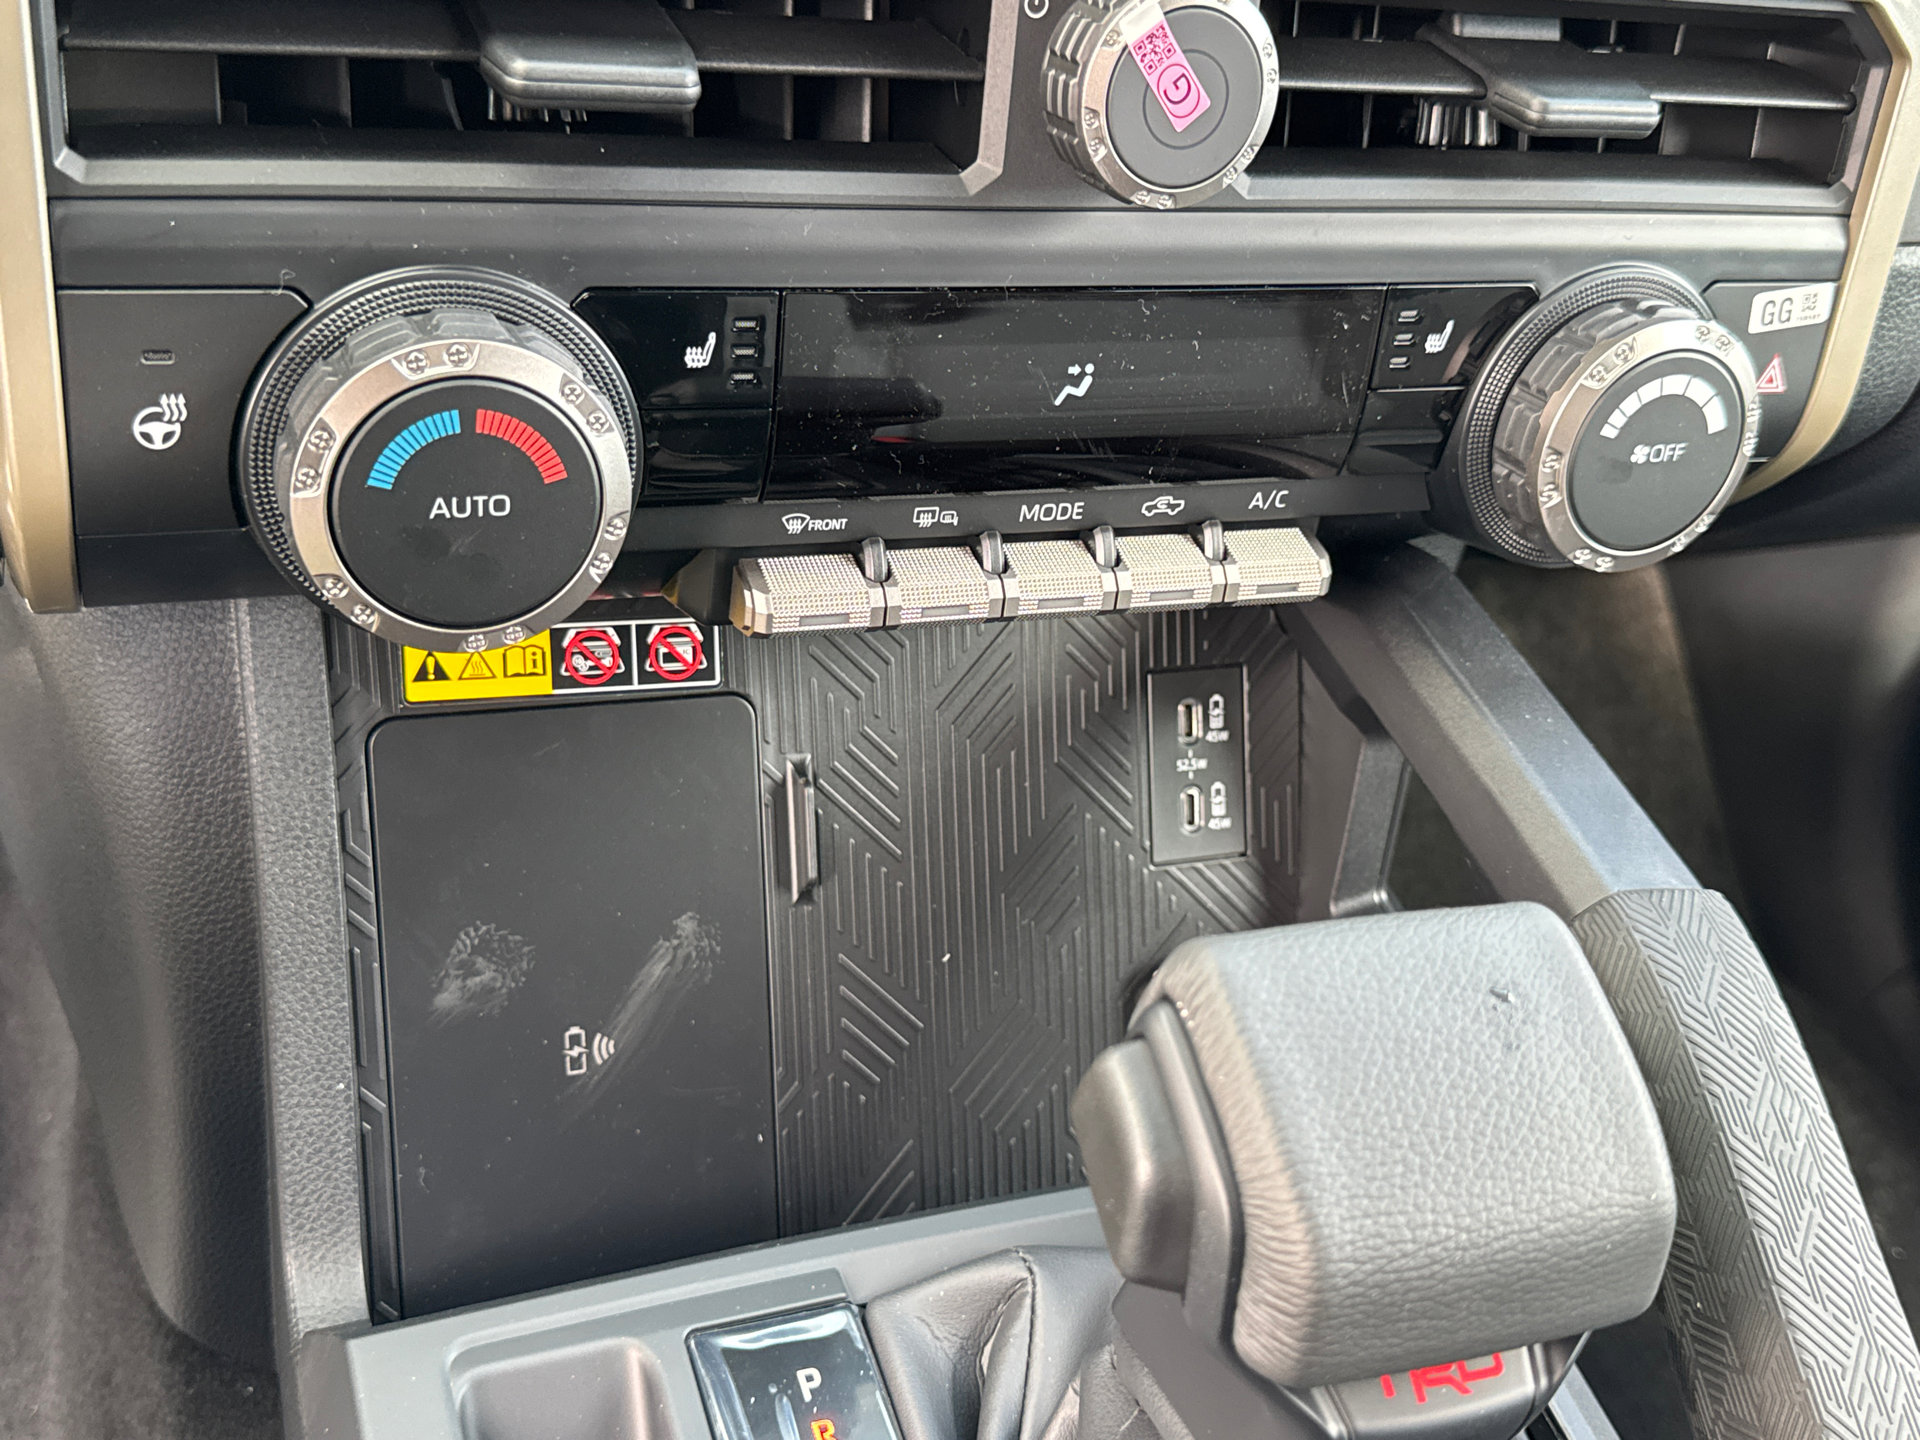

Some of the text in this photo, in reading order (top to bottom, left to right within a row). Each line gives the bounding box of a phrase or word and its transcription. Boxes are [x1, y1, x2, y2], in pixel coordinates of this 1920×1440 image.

[1163, 73, 1192, 105] G
[1761, 297, 1793, 326] GG
[1649, 443, 1688, 463] OFF
[429, 494, 511, 519] AUTO
[1249, 490, 1288, 509] A/C
[1019, 502, 1085, 522] MODE
[808, 518, 848, 531] FRONT
[796, 1367, 822, 1402] P
[810, 1419, 837, 1440] R
